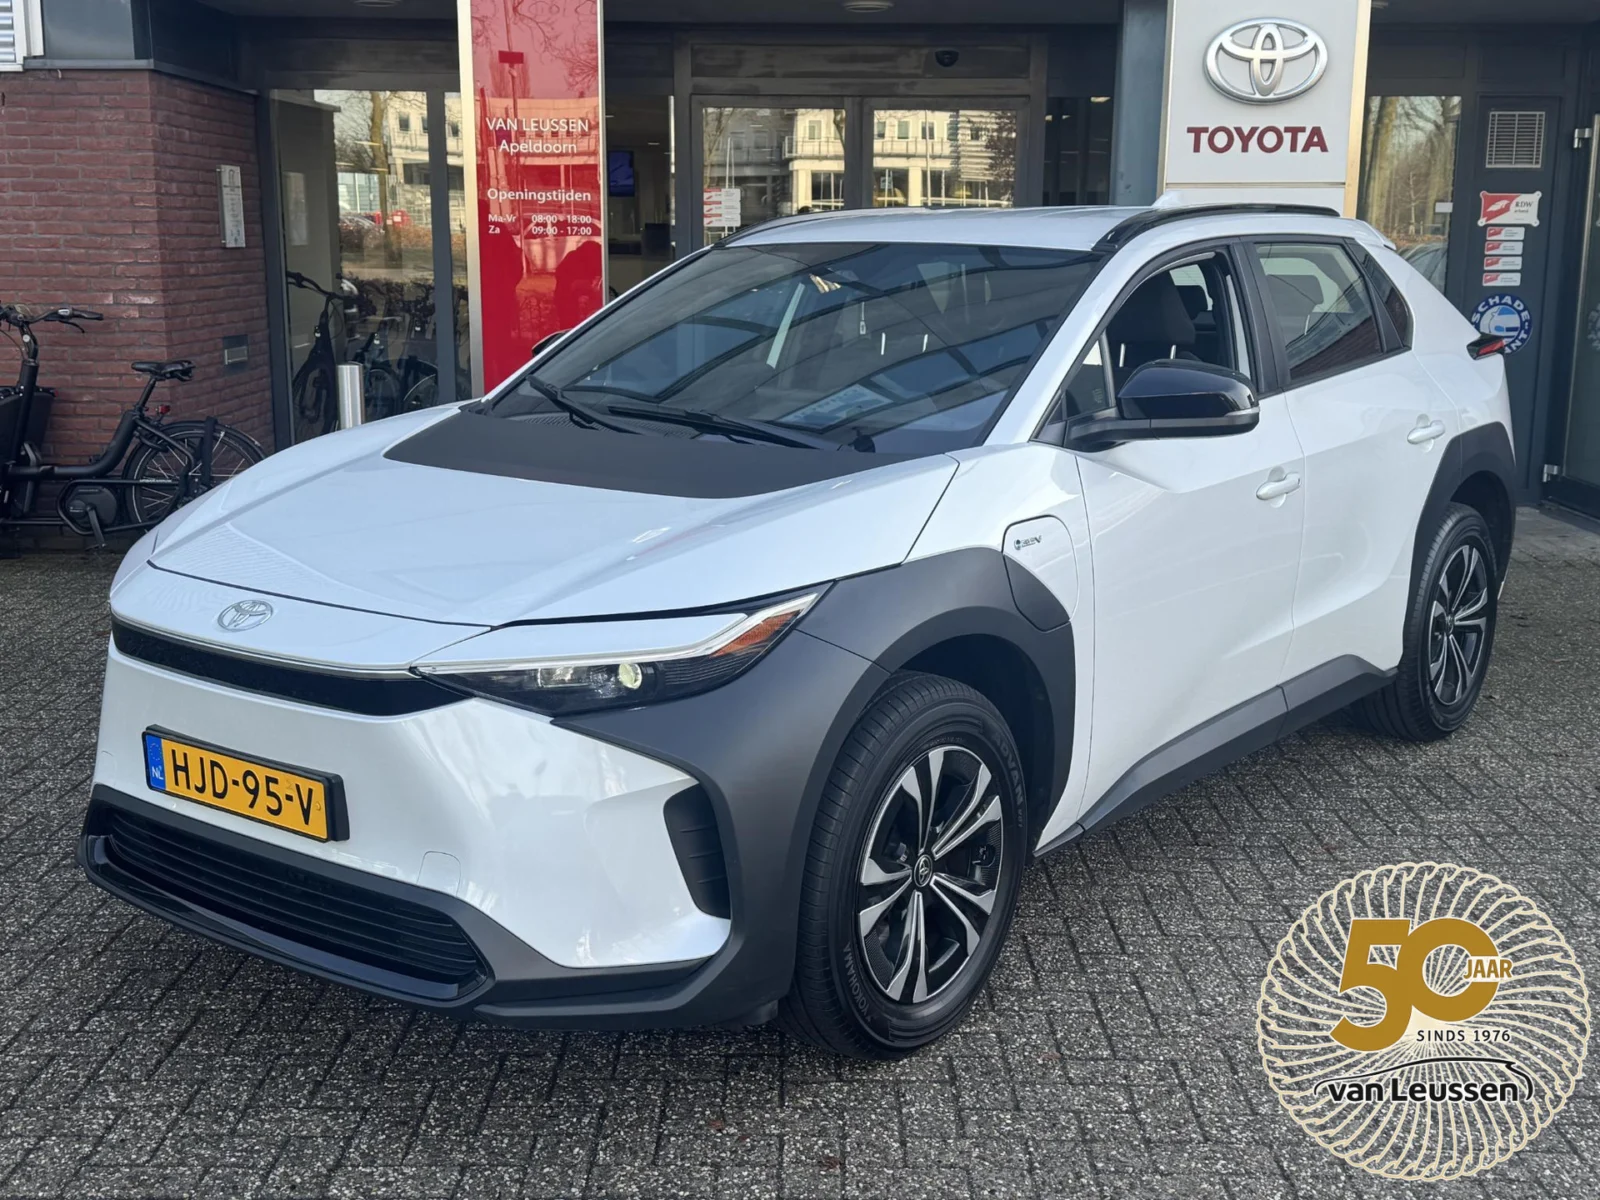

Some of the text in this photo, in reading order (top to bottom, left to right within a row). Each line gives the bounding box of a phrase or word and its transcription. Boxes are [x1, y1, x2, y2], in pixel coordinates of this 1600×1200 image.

[486, 118, 589, 132] VAN LEUSSEN
[1187, 125, 1329, 154] TOYOTA
[499, 140, 577, 155] Apeldoorn
[487, 189, 591, 203] Openingstijden
[488, 213, 516, 223] Ma-Vr
[531, 215, 557, 224] 08:00
[566, 215, 592, 224] 18:00
[488, 225, 500, 234] Za
[531, 226, 557, 235] 09:00
[567, 226, 592, 235] 17:00
[151, 766, 164, 781] NL
[171, 748, 313, 826] HJD-95-V
[843, 941, 870, 1016] YOKOHAMA
